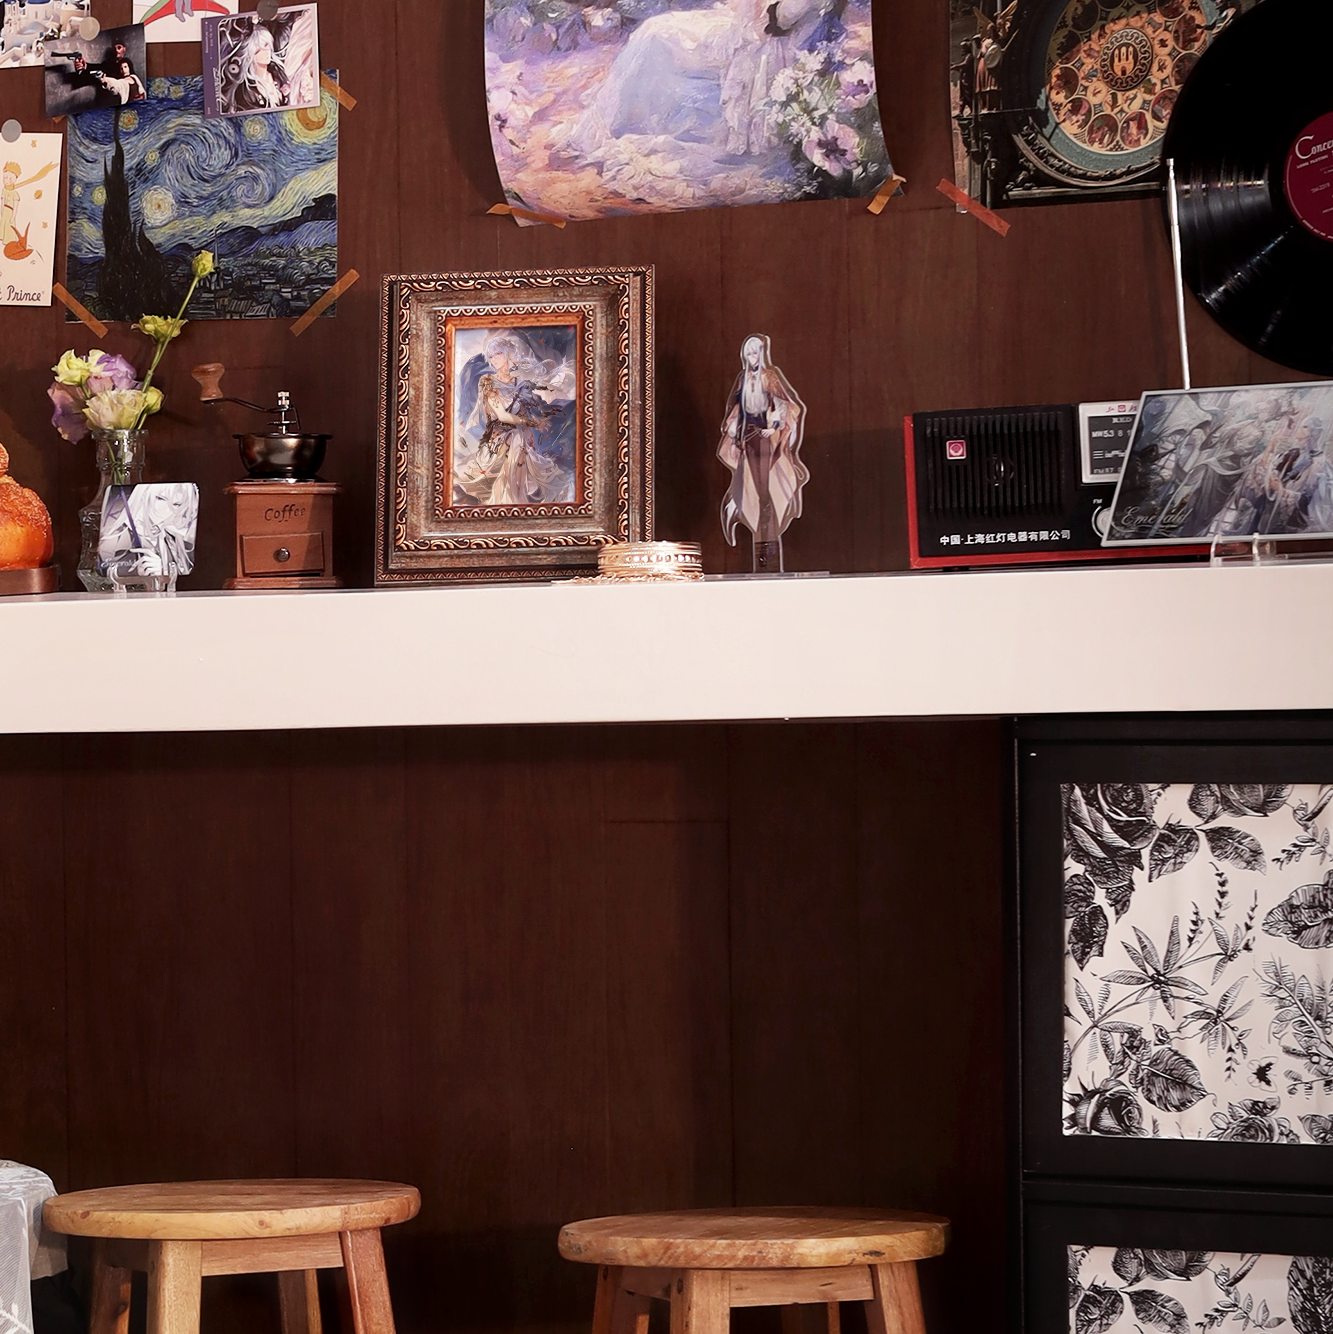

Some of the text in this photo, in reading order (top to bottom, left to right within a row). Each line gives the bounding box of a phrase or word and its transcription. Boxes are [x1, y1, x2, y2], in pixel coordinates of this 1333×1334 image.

[6, 284, 42, 302] Prince
[264, 503, 306, 523] Coffee
[1121, 506, 1193, 526] Emeald
[939, 529, 1071, 546] 中国·上海红灯电器有限公司
